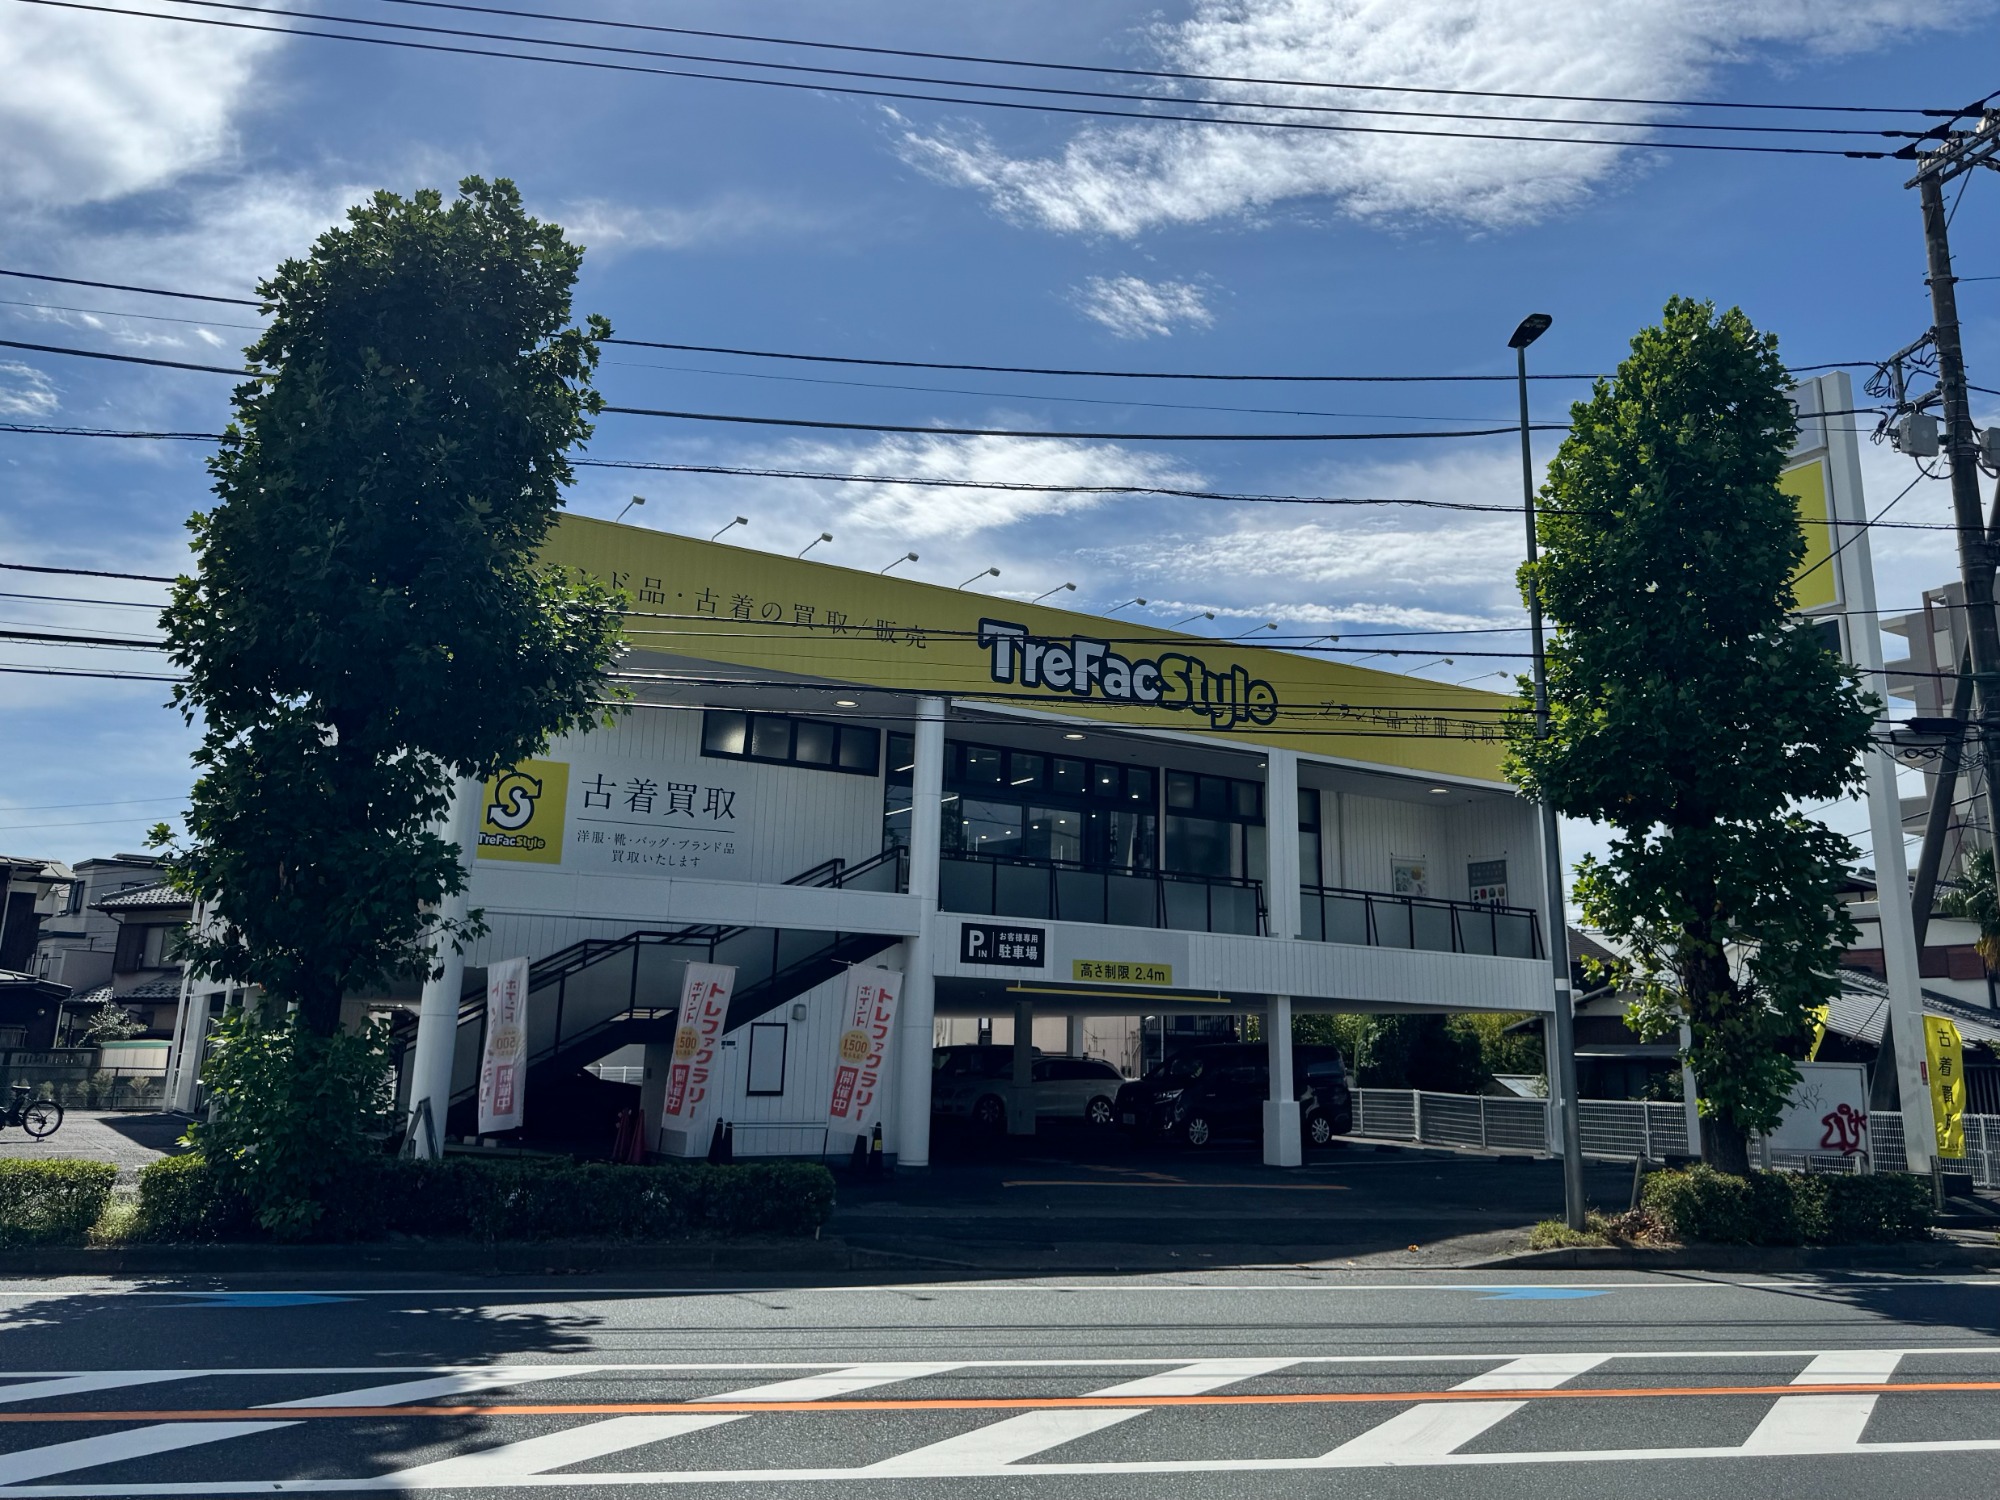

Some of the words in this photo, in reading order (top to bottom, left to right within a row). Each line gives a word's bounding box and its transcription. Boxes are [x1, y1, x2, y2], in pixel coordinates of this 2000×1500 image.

[978, 617, 1279, 730] TreFacStyle
[581, 773, 737, 821] 古着買取
[478, 831, 546, 851] TreFacStyle
[577, 829, 736, 855] 洋服・靴・バッグ・ブランド品
[611, 849, 701, 868] 買取いたします
[968, 929, 985, 957] P
[999, 932, 1039, 944] お客様専用
[978, 949, 988, 958] IN
[998, 944, 1039, 961] 駐車場
[1080, 962, 1130, 980] 高さ制限
[1135, 967, 1165, 982] 2.4m
[685, 981, 704, 1024] ポイント
[855, 985, 873, 1027] ポイント
[689, 982, 726, 1119] トレファクラリー
[856, 987, 894, 1122] トレファクラリー
[833, 1070, 855, 1111] 開催中
